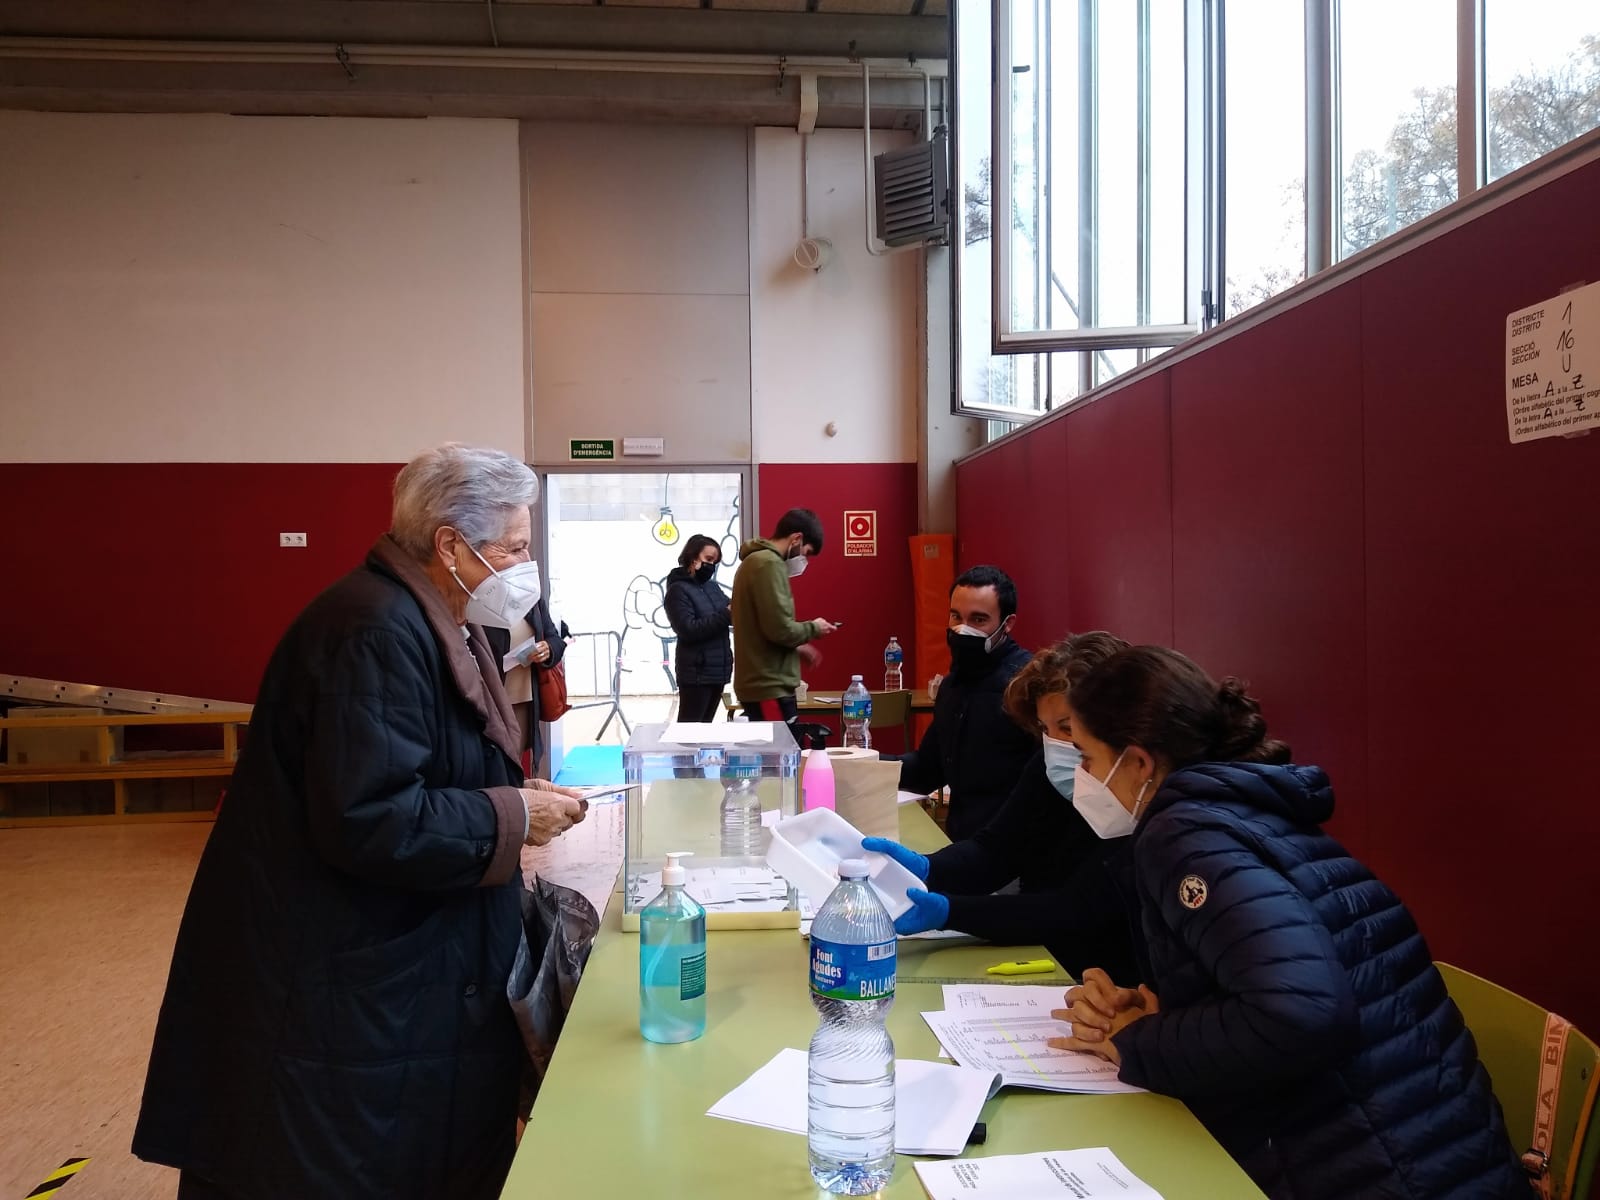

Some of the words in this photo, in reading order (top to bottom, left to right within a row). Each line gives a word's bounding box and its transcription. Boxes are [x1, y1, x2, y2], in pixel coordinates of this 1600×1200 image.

[1511, 309, 1545, 328] DISTRICTE
[1561, 301, 1572, 325] 1
[1511, 320, 1541, 338] DISTRITO
[1556, 328, 1575, 352] 16
[1511, 372, 1539, 390] MESA
[1545, 380, 1555, 398] A
[1544, 407, 1553, 420] A
[1562, 416, 1572, 426] del
[1572, 413, 1593, 425] primer
[816, 948, 833, 964] Font
